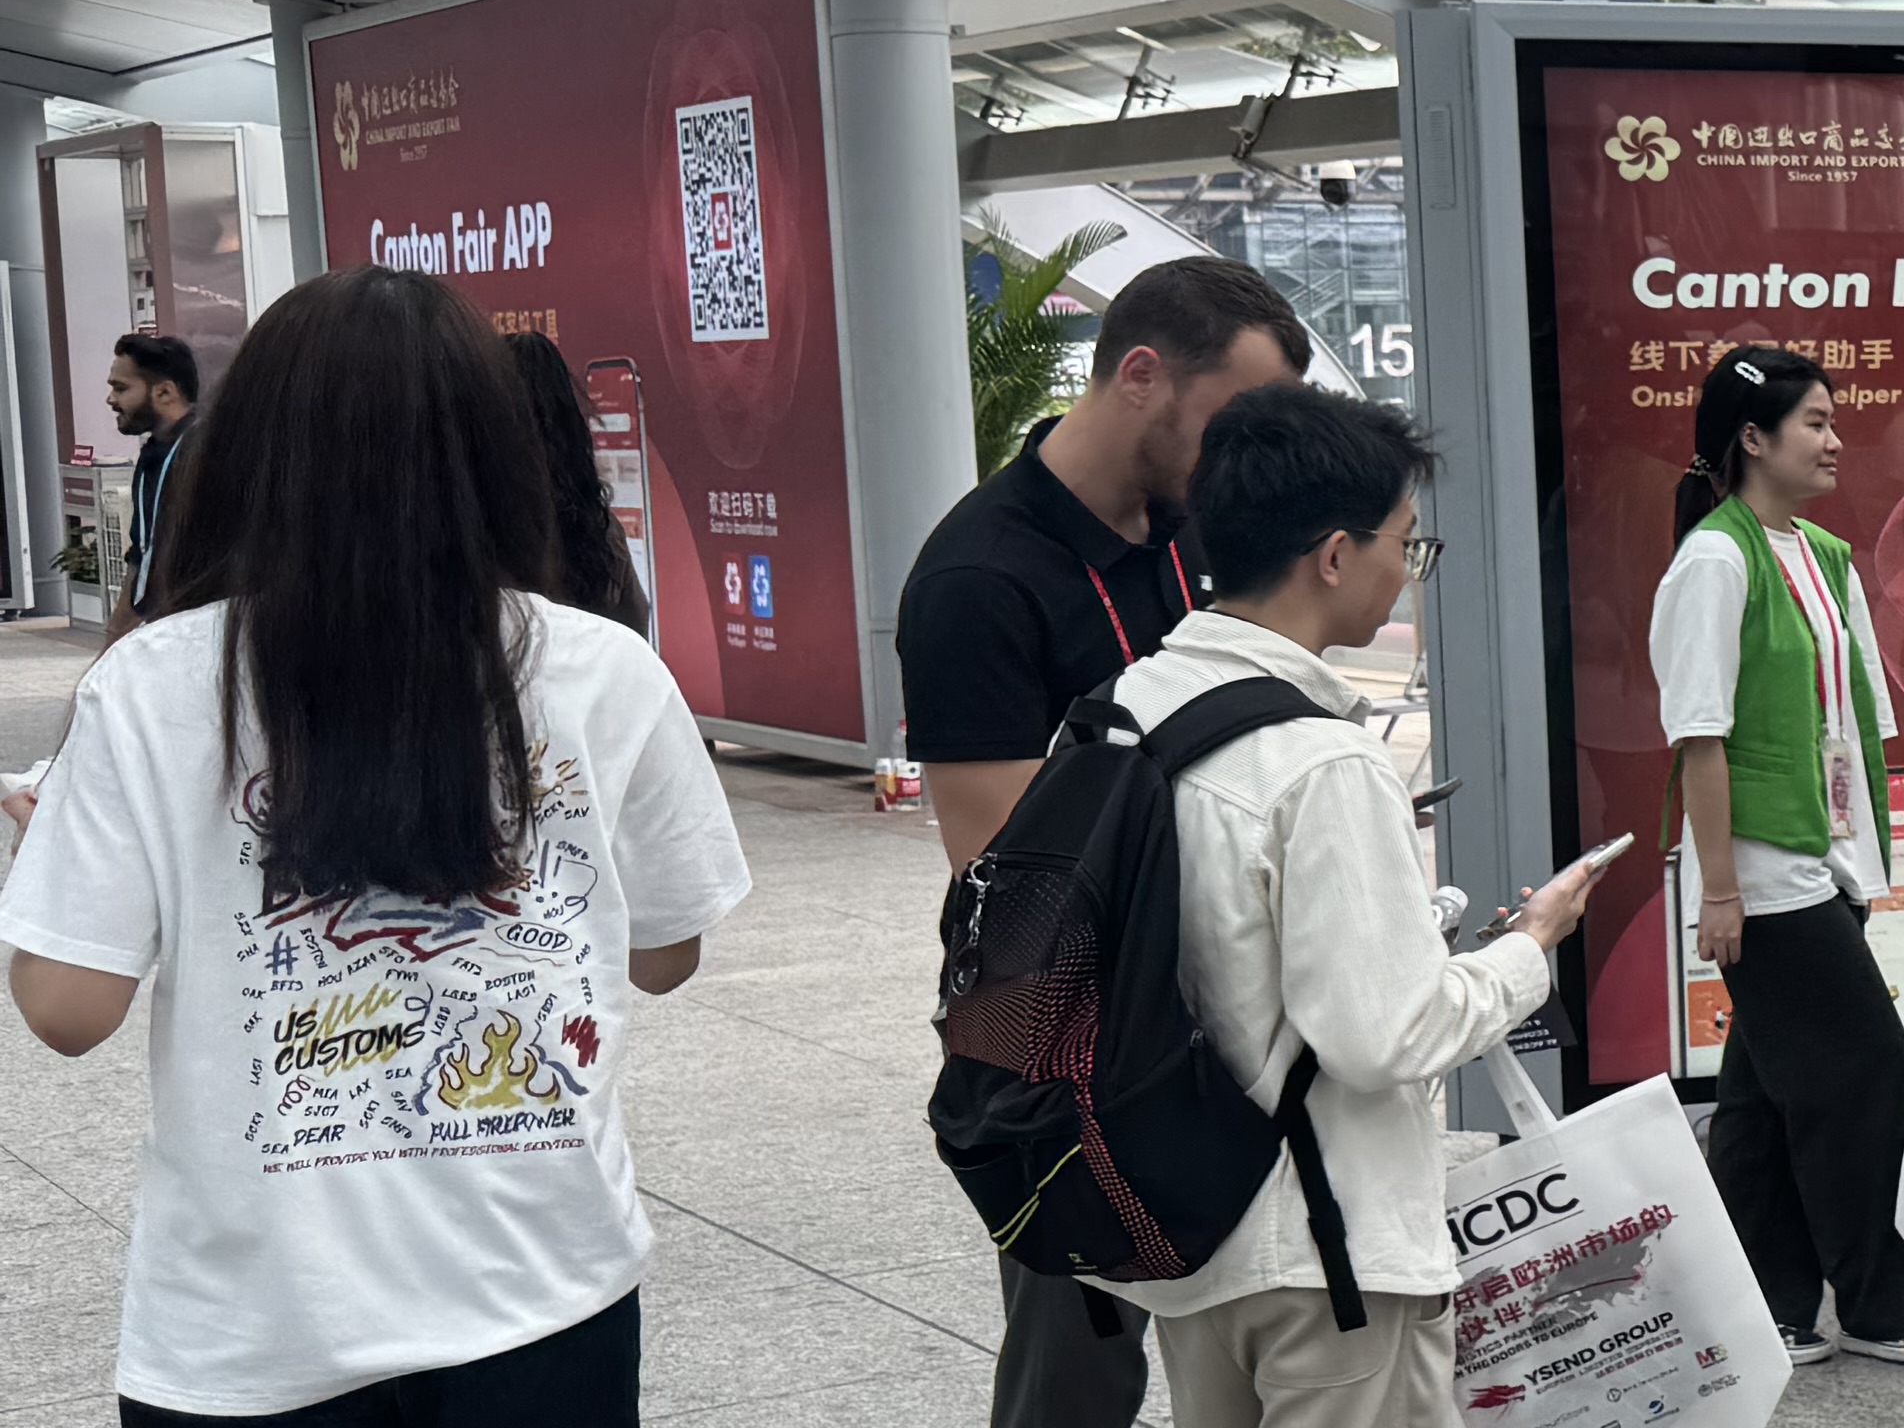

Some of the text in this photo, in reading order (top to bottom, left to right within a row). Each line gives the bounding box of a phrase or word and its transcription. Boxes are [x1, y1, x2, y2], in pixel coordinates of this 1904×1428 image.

[1697, 154, 1746, 167] CHINA
[1750, 155, 1808, 167] IMPORT
[1813, 155, 1847, 168] AND
[1788, 171, 1823, 183] Since
[370, 201, 552, 275] Canton Fair APP
[1631, 256, 1870, 310] Canton
[1351, 323, 1414, 378] 15
[1630, 385, 1697, 408] Onsi
[1833, 384, 1902, 408] elper
[507, 924, 568, 950] GOOD
[274, 1009, 318, 1043] US
[275, 1020, 425, 1075] CUSTOMS
[313, 1087, 339, 1100] MIA
[349, 1078, 373, 1099] LAX
[293, 1124, 346, 1147] DEAR
[430, 1120, 472, 1144] FULL
[372, 1148, 396, 1161] YOU
[1524, 1347, 1597, 1387] YSEND
[1598, 1311, 1674, 1355] GROUP
